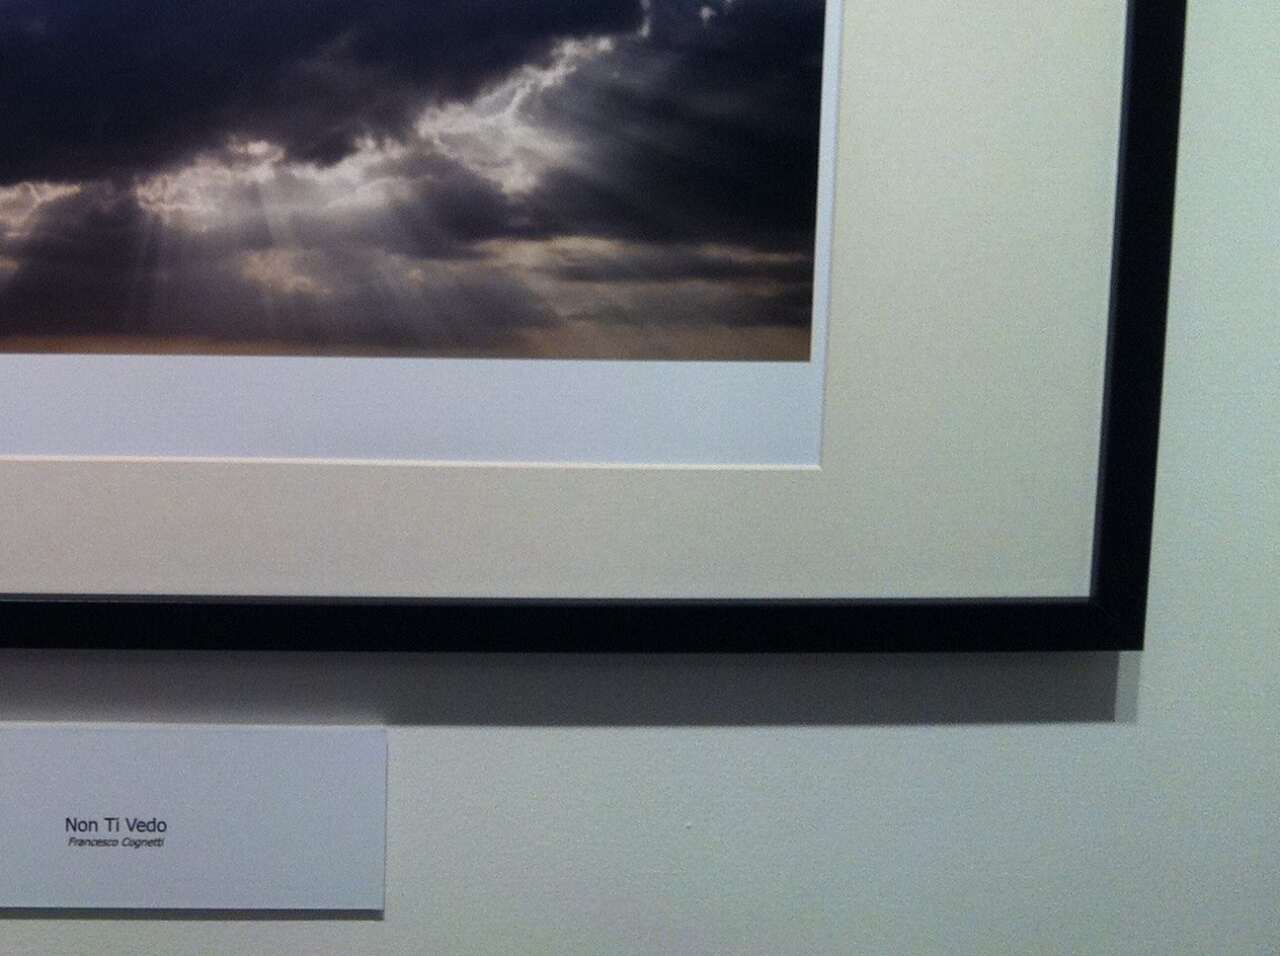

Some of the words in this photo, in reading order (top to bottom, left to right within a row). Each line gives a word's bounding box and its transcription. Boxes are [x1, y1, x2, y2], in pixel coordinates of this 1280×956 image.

[65, 817, 99, 833] Non
[104, 817, 120, 833] Ti
[125, 817, 168, 833] Vedo
[67, 837, 119, 847] Francesco
[121, 837, 165, 849] Cognetti
